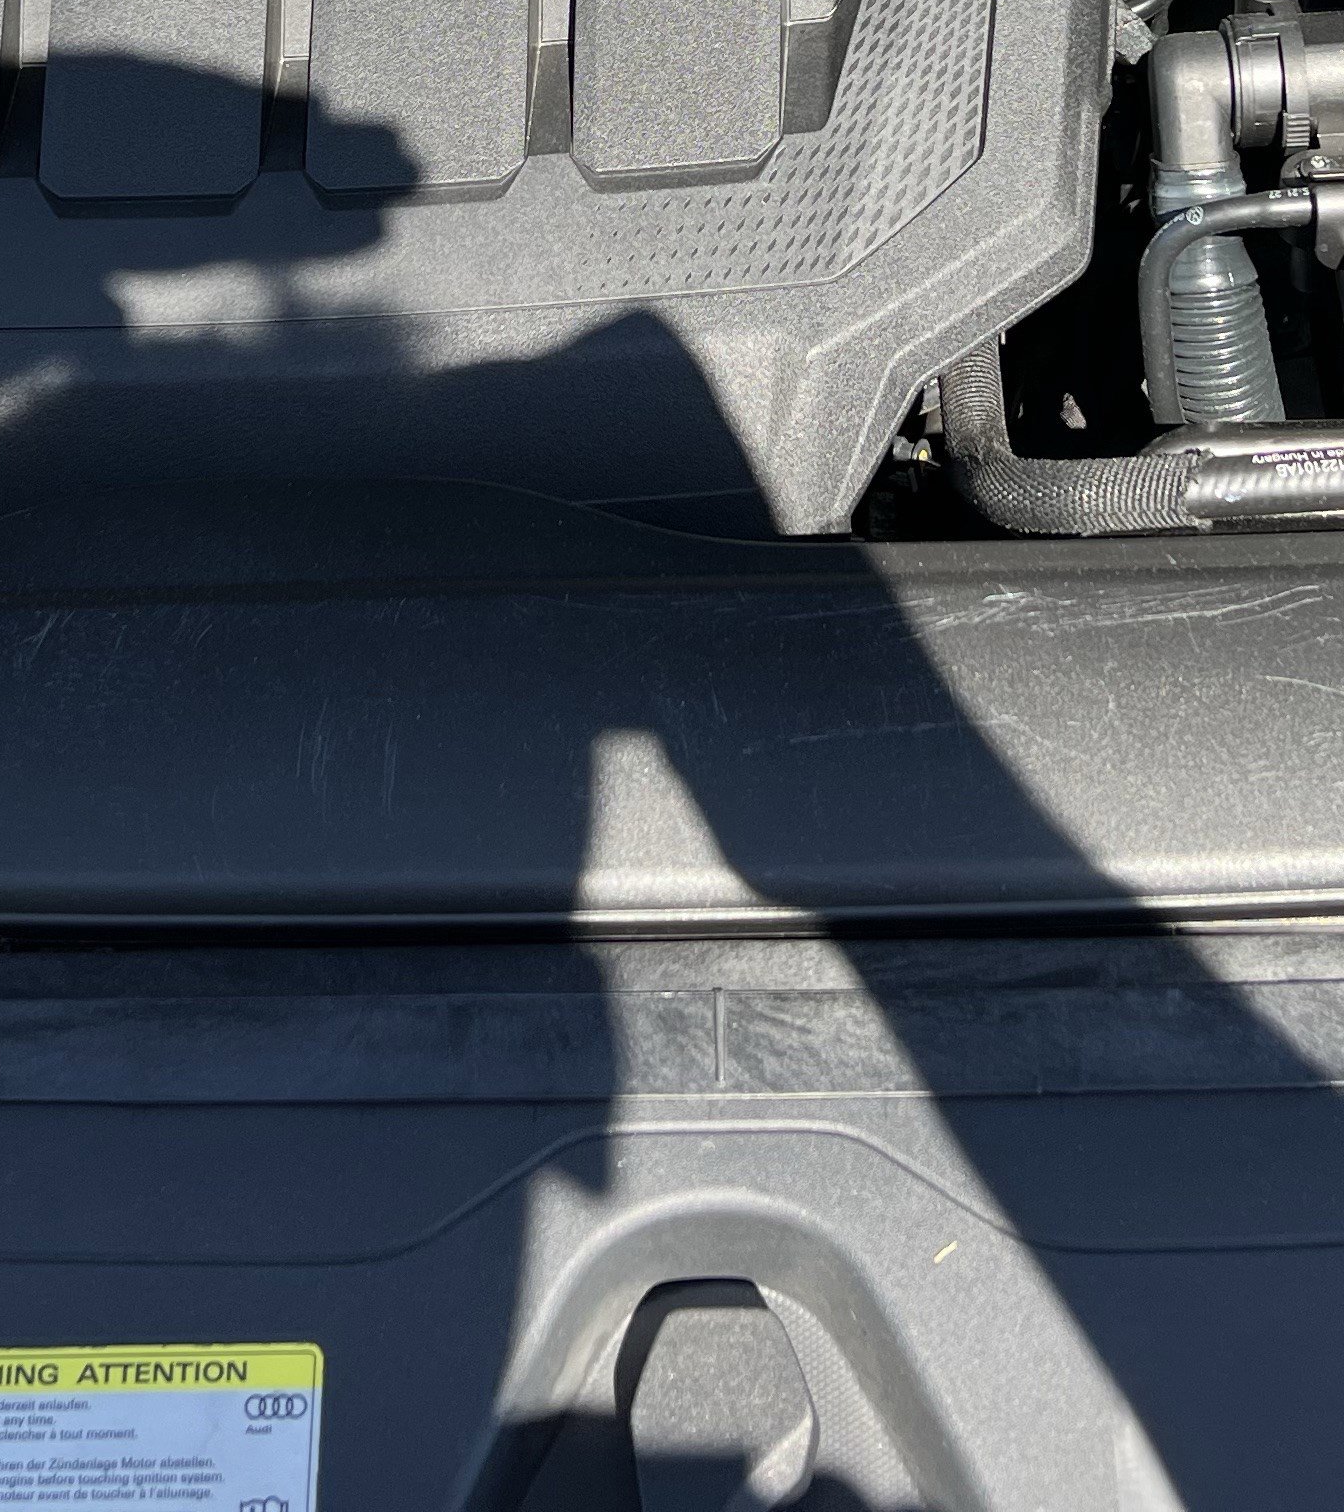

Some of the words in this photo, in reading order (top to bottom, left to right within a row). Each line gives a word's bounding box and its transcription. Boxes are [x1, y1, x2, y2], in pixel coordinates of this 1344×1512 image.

[1251, 451, 1308, 465] Hungary
[1311, 450, 1324, 459] in
[77, 1360, 249, 1385] ATTENTION
[3, 1416, 24, 1428] any
[60, 1428, 83, 1439] tout
[86, 1428, 138, 1439] moment.
[245, 1424, 272, 1435] Audi
[27, 1458, 46, 1471] der
[48, 1456, 118, 1473] Zündanlage
[121, 1456, 156, 1469] Motor
[159, 1455, 216, 1469] abstellen.
[37, 1472, 74, 1486] before
[78, 1471, 129, 1487] touching
[132, 1471, 177, 1486] ignition
[37, 1489, 70, 1500] avant
[73, 1488, 88, 1500] de
[91, 1487, 135, 1500] toucher
